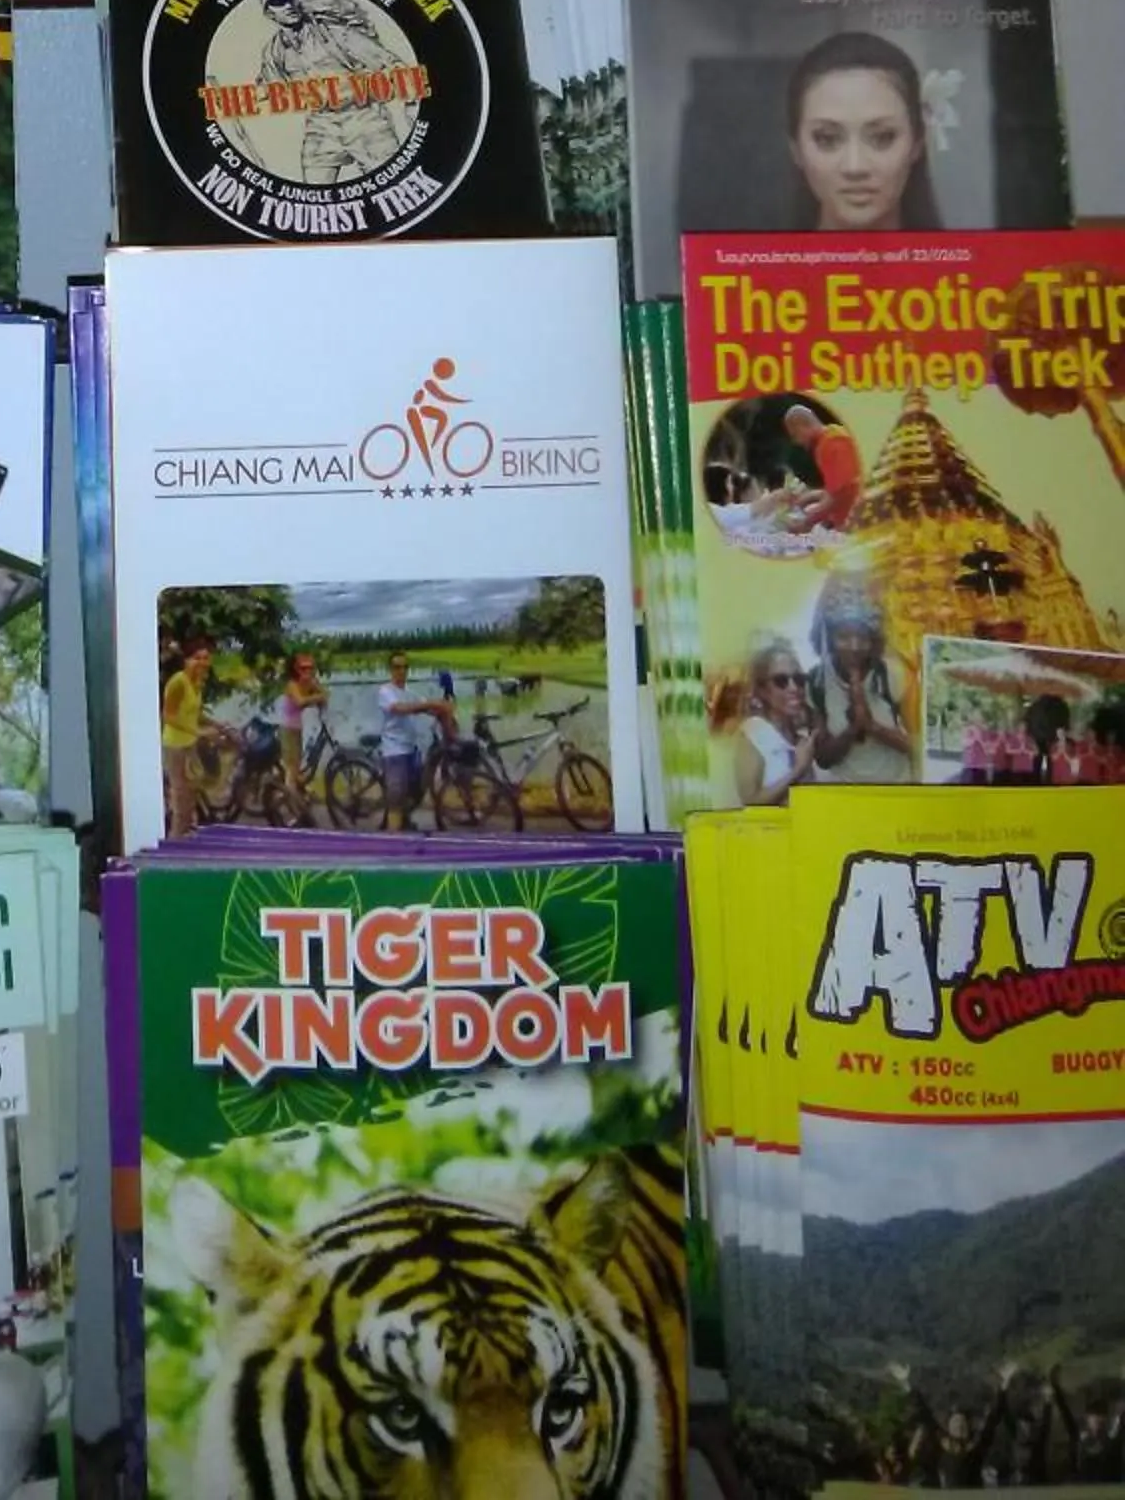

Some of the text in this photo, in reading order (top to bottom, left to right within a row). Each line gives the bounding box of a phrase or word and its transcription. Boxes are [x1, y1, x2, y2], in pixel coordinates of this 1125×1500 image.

[199, 63, 431, 122] THE BEST VOTE
[205, 119, 429, 203] WE DO REAL JUNGLE 100% GUARANTEE
[196, 163, 444, 235] NON TOURIST TREK
[699, 271, 1125, 344] The Exotic Trip
[715, 337, 1113, 402] Doi Suthep Trek
[154, 446, 602, 489] CHIANG MAI BIKING
[259, 904, 560, 991] TIGER
[807, 851, 1095, 1041] ATV
[190, 981, 634, 1088] KINGDOM
[836, 1051, 885, 1075] ATV
[909, 1056, 976, 1078] 150cc
[1051, 1050, 1125, 1074] BUGGY
[908, 1085, 1020, 1109] 450cc (4x4)
